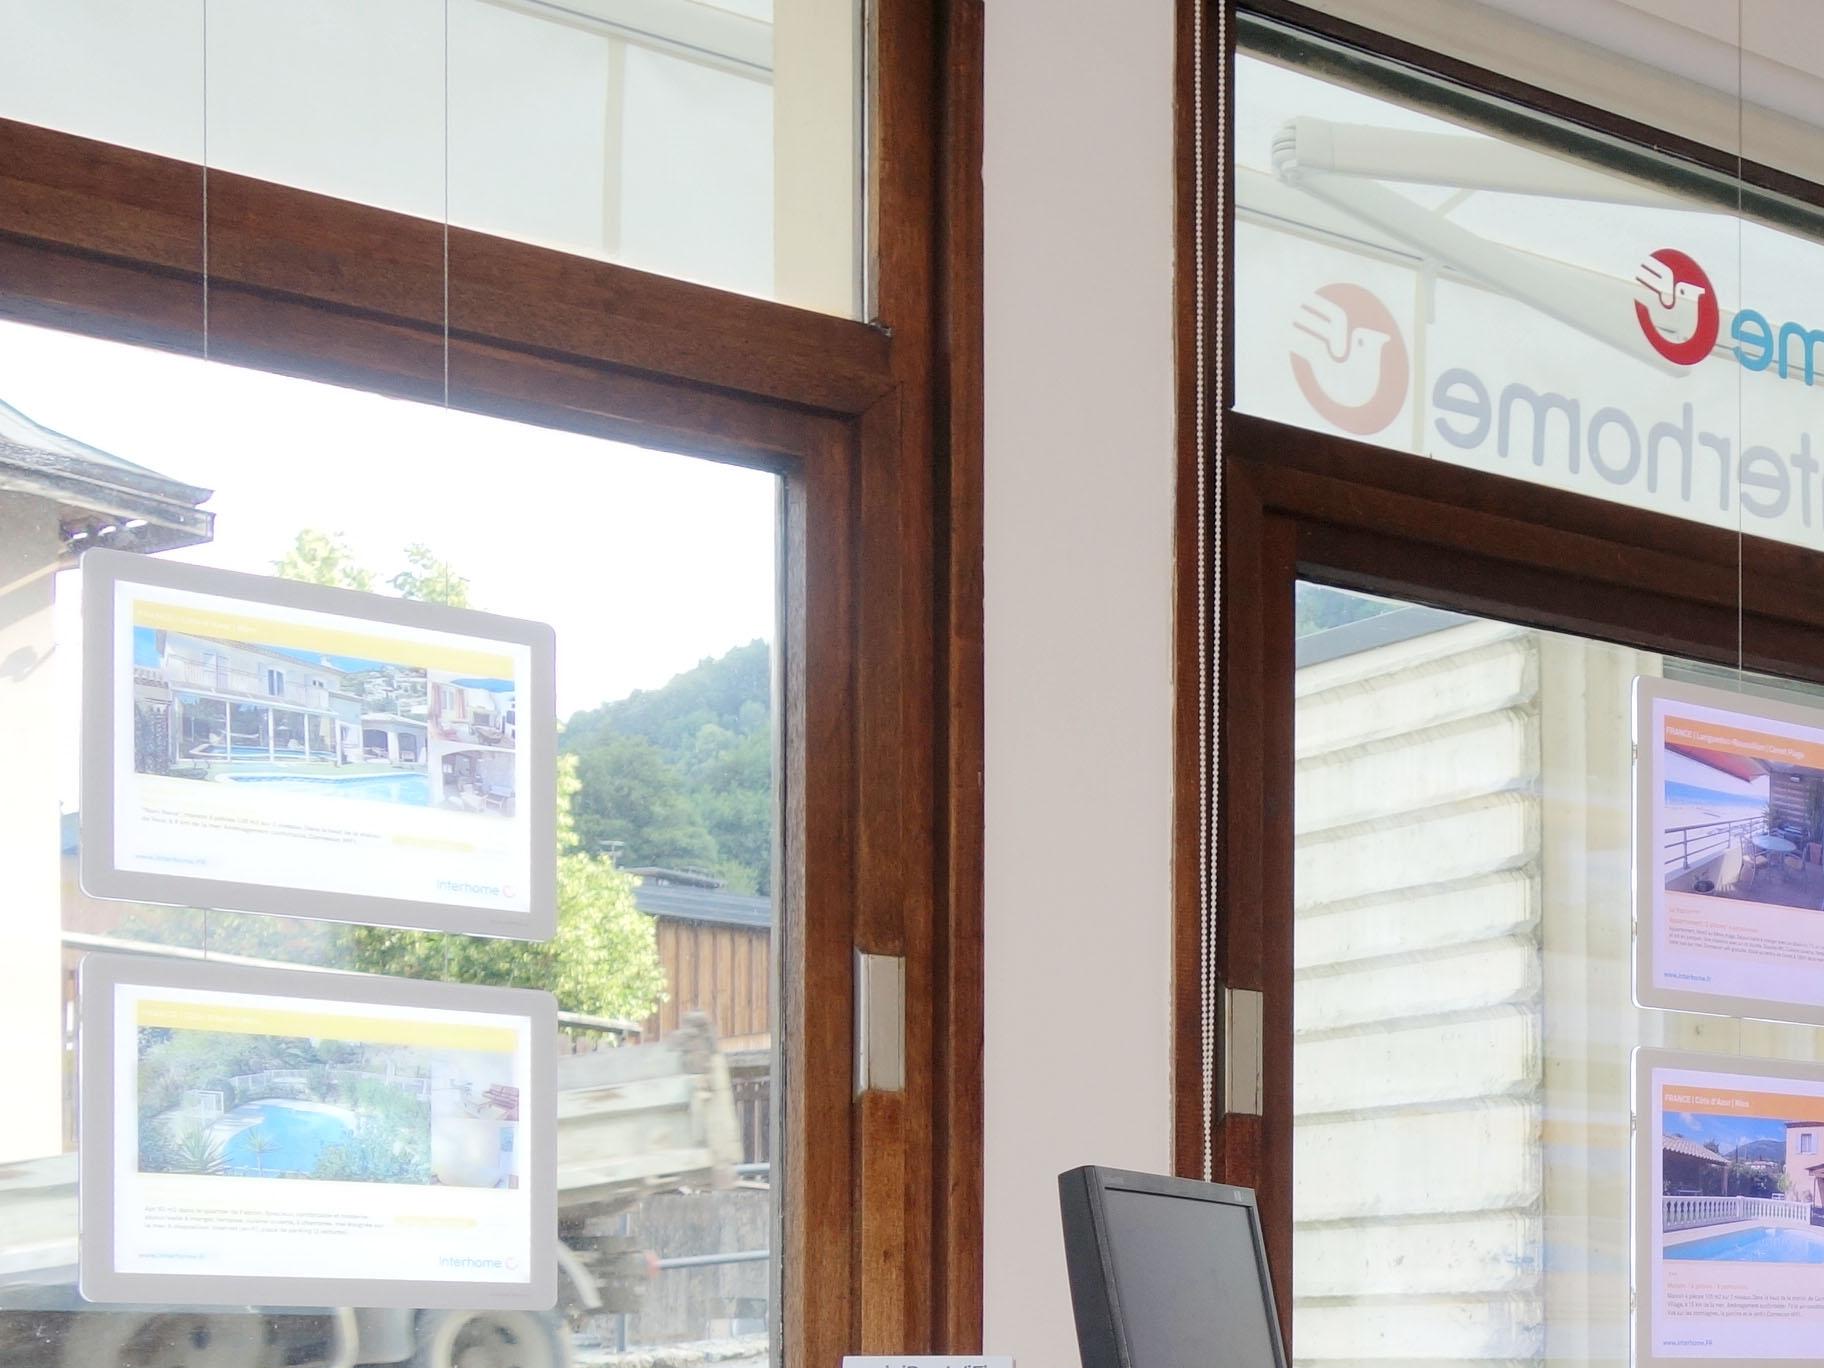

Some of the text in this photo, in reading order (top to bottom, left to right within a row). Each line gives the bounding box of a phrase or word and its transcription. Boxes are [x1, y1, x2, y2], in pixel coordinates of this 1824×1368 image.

[437, 880, 500, 896] Interhome
[1664, 1094, 1691, 1105] FRANCE
[438, 1256, 503, 1269] Interhome
